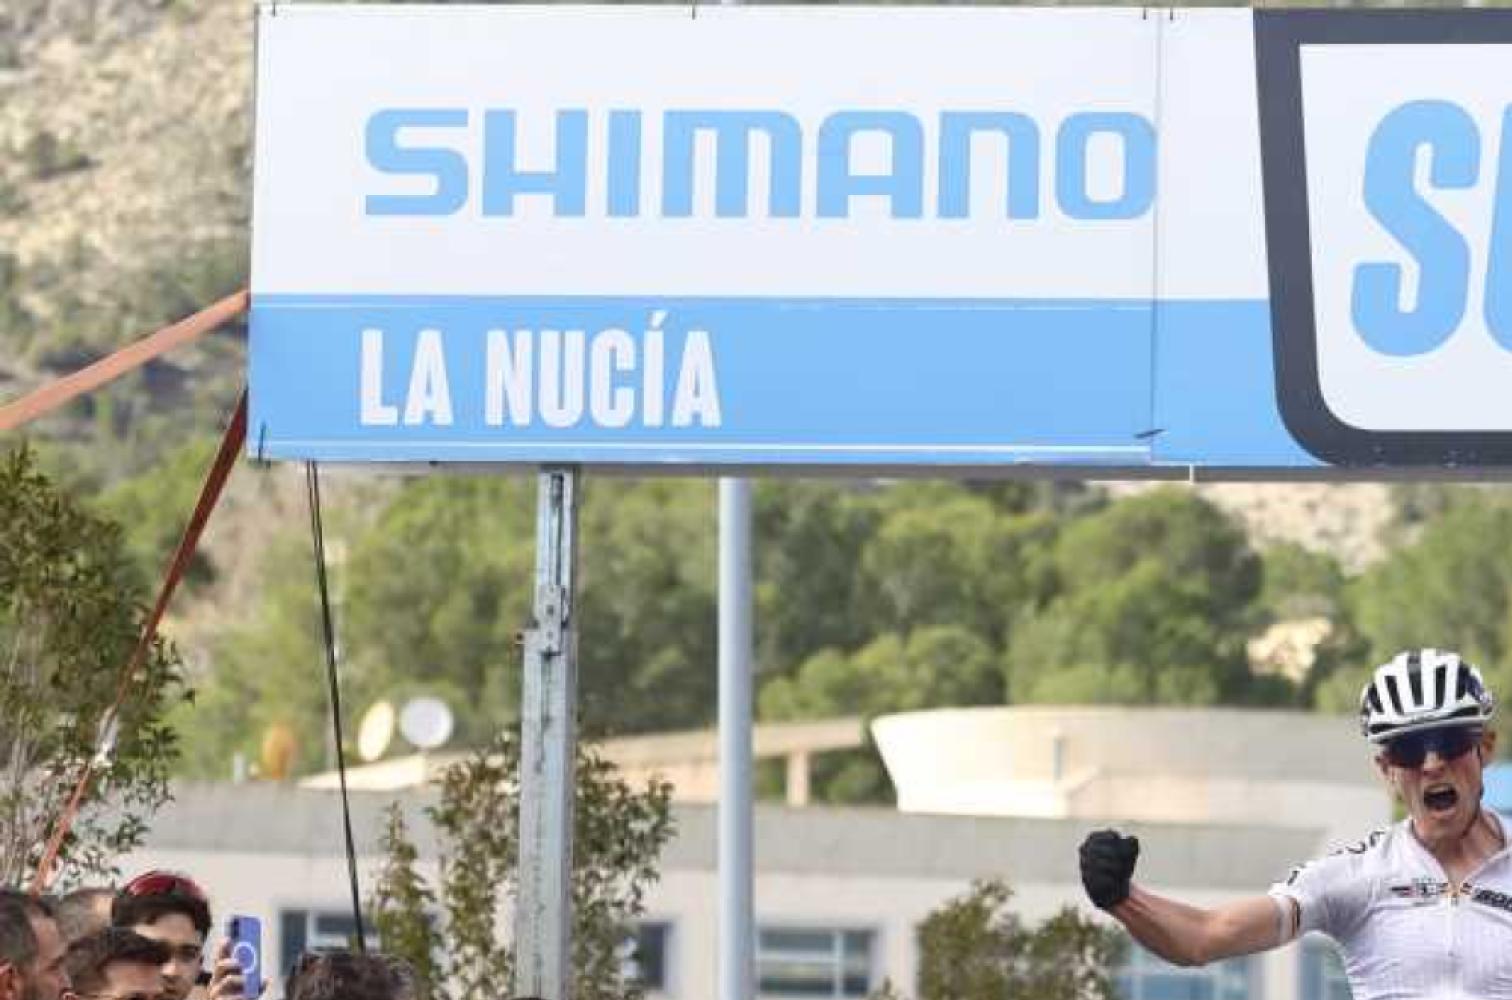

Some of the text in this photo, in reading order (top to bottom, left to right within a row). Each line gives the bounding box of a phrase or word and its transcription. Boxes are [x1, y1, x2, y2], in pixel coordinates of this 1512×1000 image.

[364, 107, 1156, 221] SHIMANO
[360, 311, 723, 428] LA NUCÍA
